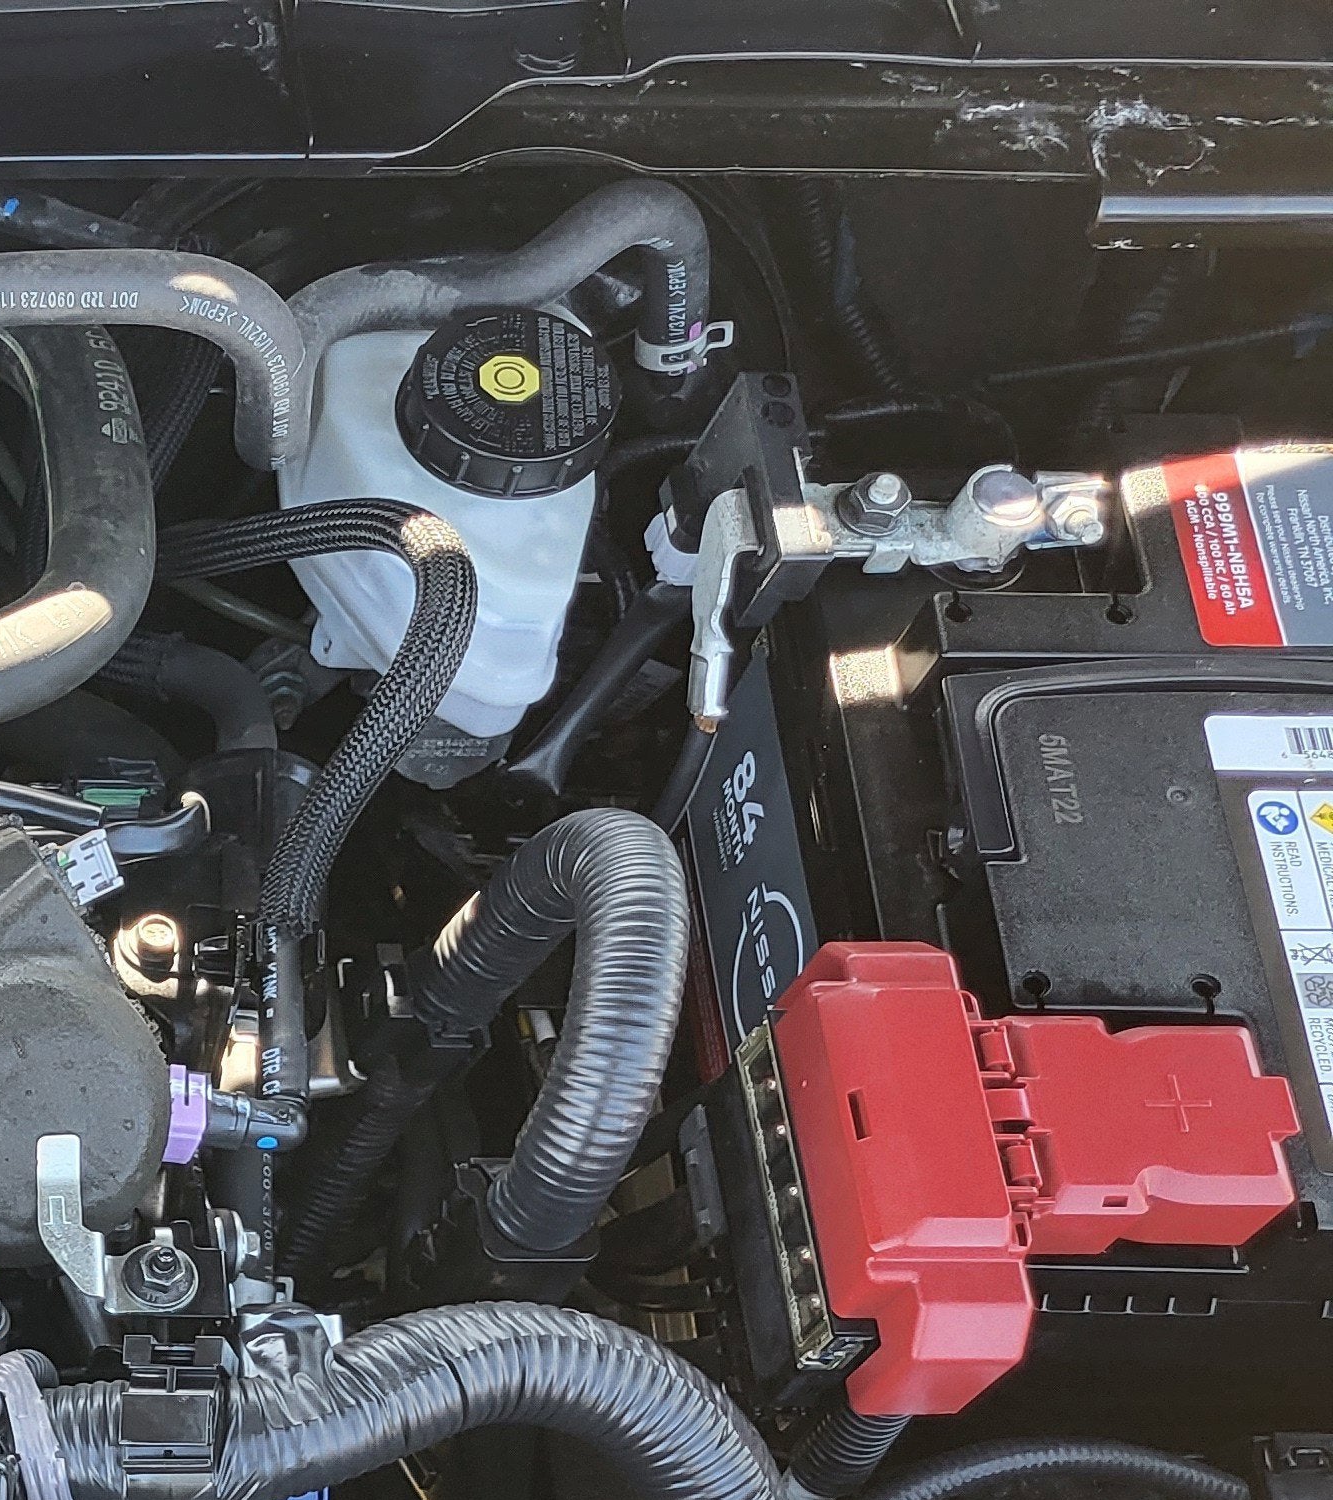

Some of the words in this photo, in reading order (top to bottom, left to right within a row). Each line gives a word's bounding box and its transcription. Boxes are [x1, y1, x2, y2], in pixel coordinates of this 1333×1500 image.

[21, 291, 75, 309] 090723
[110, 291, 139, 309] DOT
[1296, 489, 1313, 520] Nissan
[1201, 507, 1215, 529] CCA
[1304, 519, 1322, 546] North
[1184, 499, 1201, 524] AGM
[1193, 533, 1217, 600] Nonspillable
[1208, 539, 1222, 558] 100
[1297, 545, 1311, 560] TN
[1213, 560, 1227, 575] RC
[1223, 600, 1236, 615] Ah
[733, 750, 765, 846] 84
[722, 777, 745, 866] MONTH
[1284, 841, 1302, 867] READ
[1269, 841, 1299, 917] INSTRUCTIONS.
[747, 886, 778, 999] NISS
[1308, 1017, 1332, 1075] RECYCLED.
